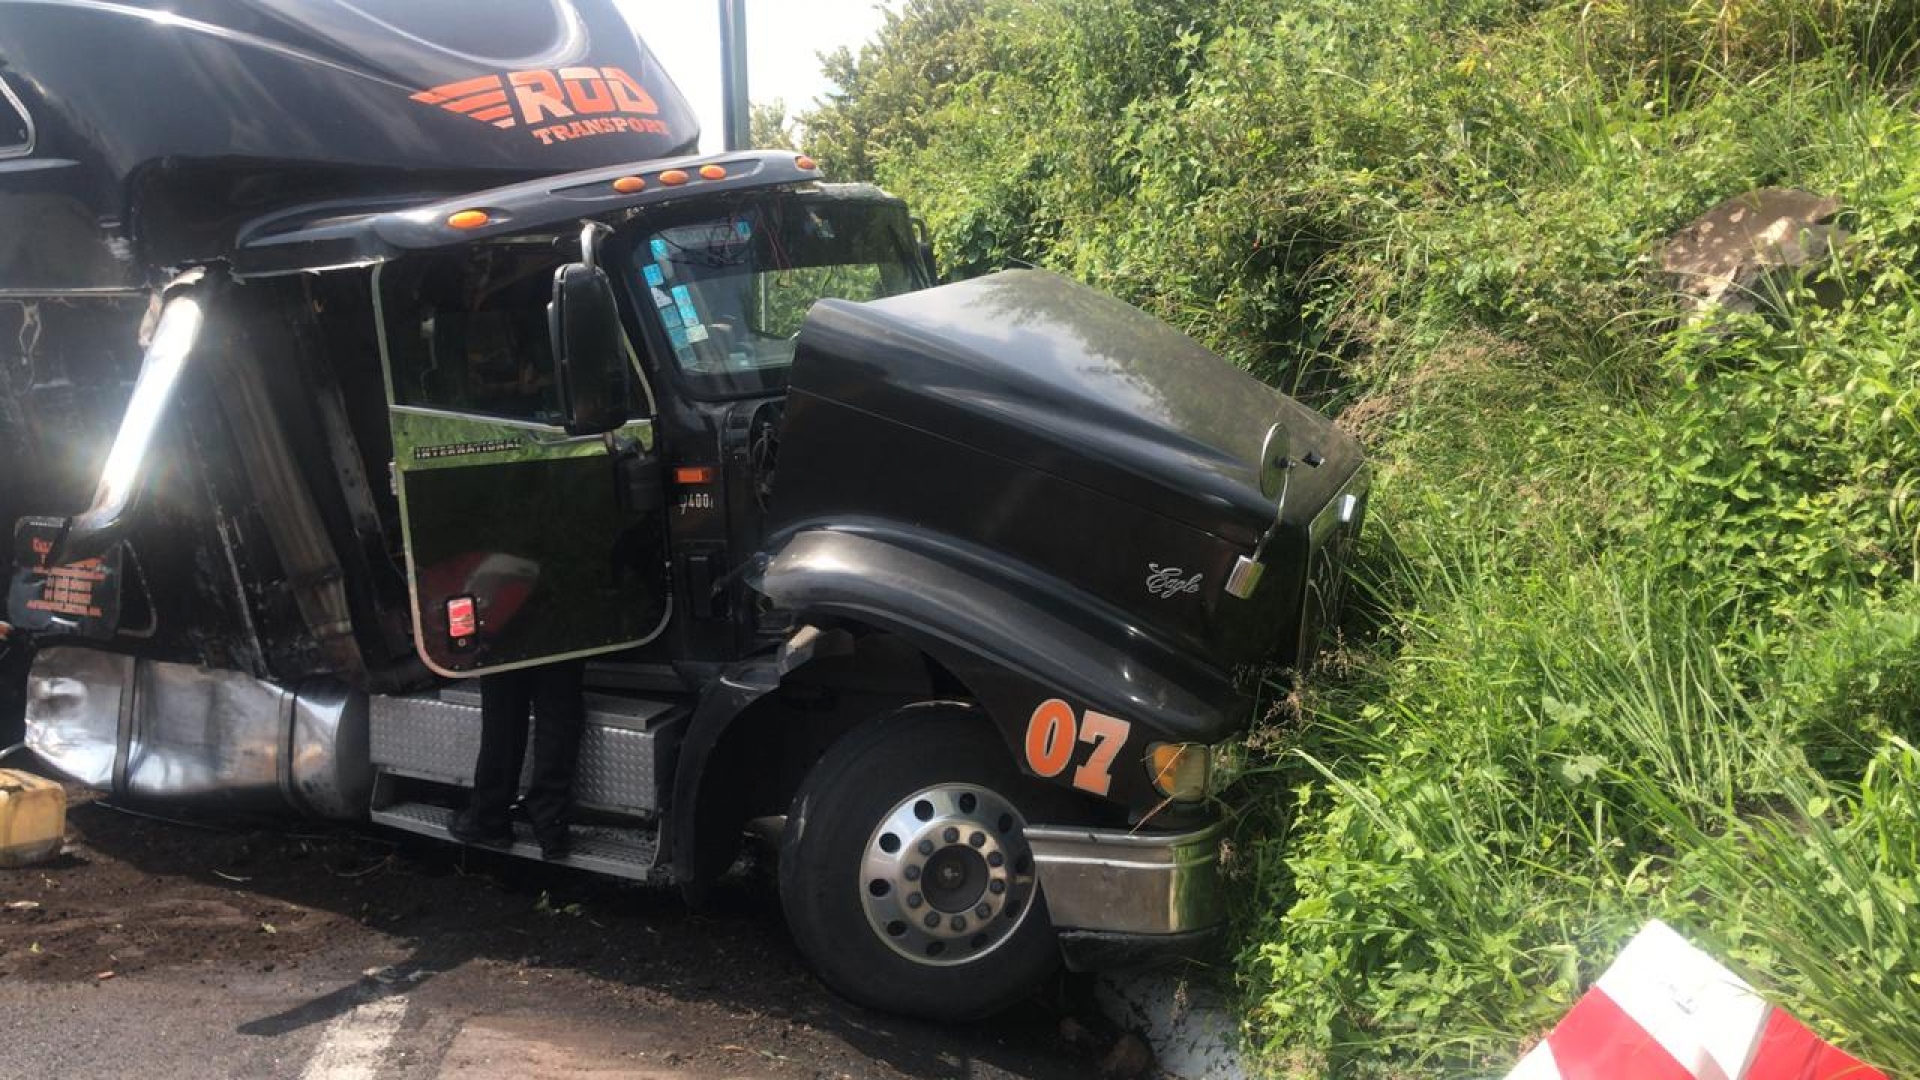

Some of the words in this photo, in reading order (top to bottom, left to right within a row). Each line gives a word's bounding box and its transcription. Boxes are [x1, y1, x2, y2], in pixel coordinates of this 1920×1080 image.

[506, 66, 660, 124] ROD
[531, 117, 671, 145] TRANSPORT
[414, 438, 521, 459] INTERNATIONAL
[1145, 563, 1203, 599] Eagle
[1025, 698, 1131, 797] 07
